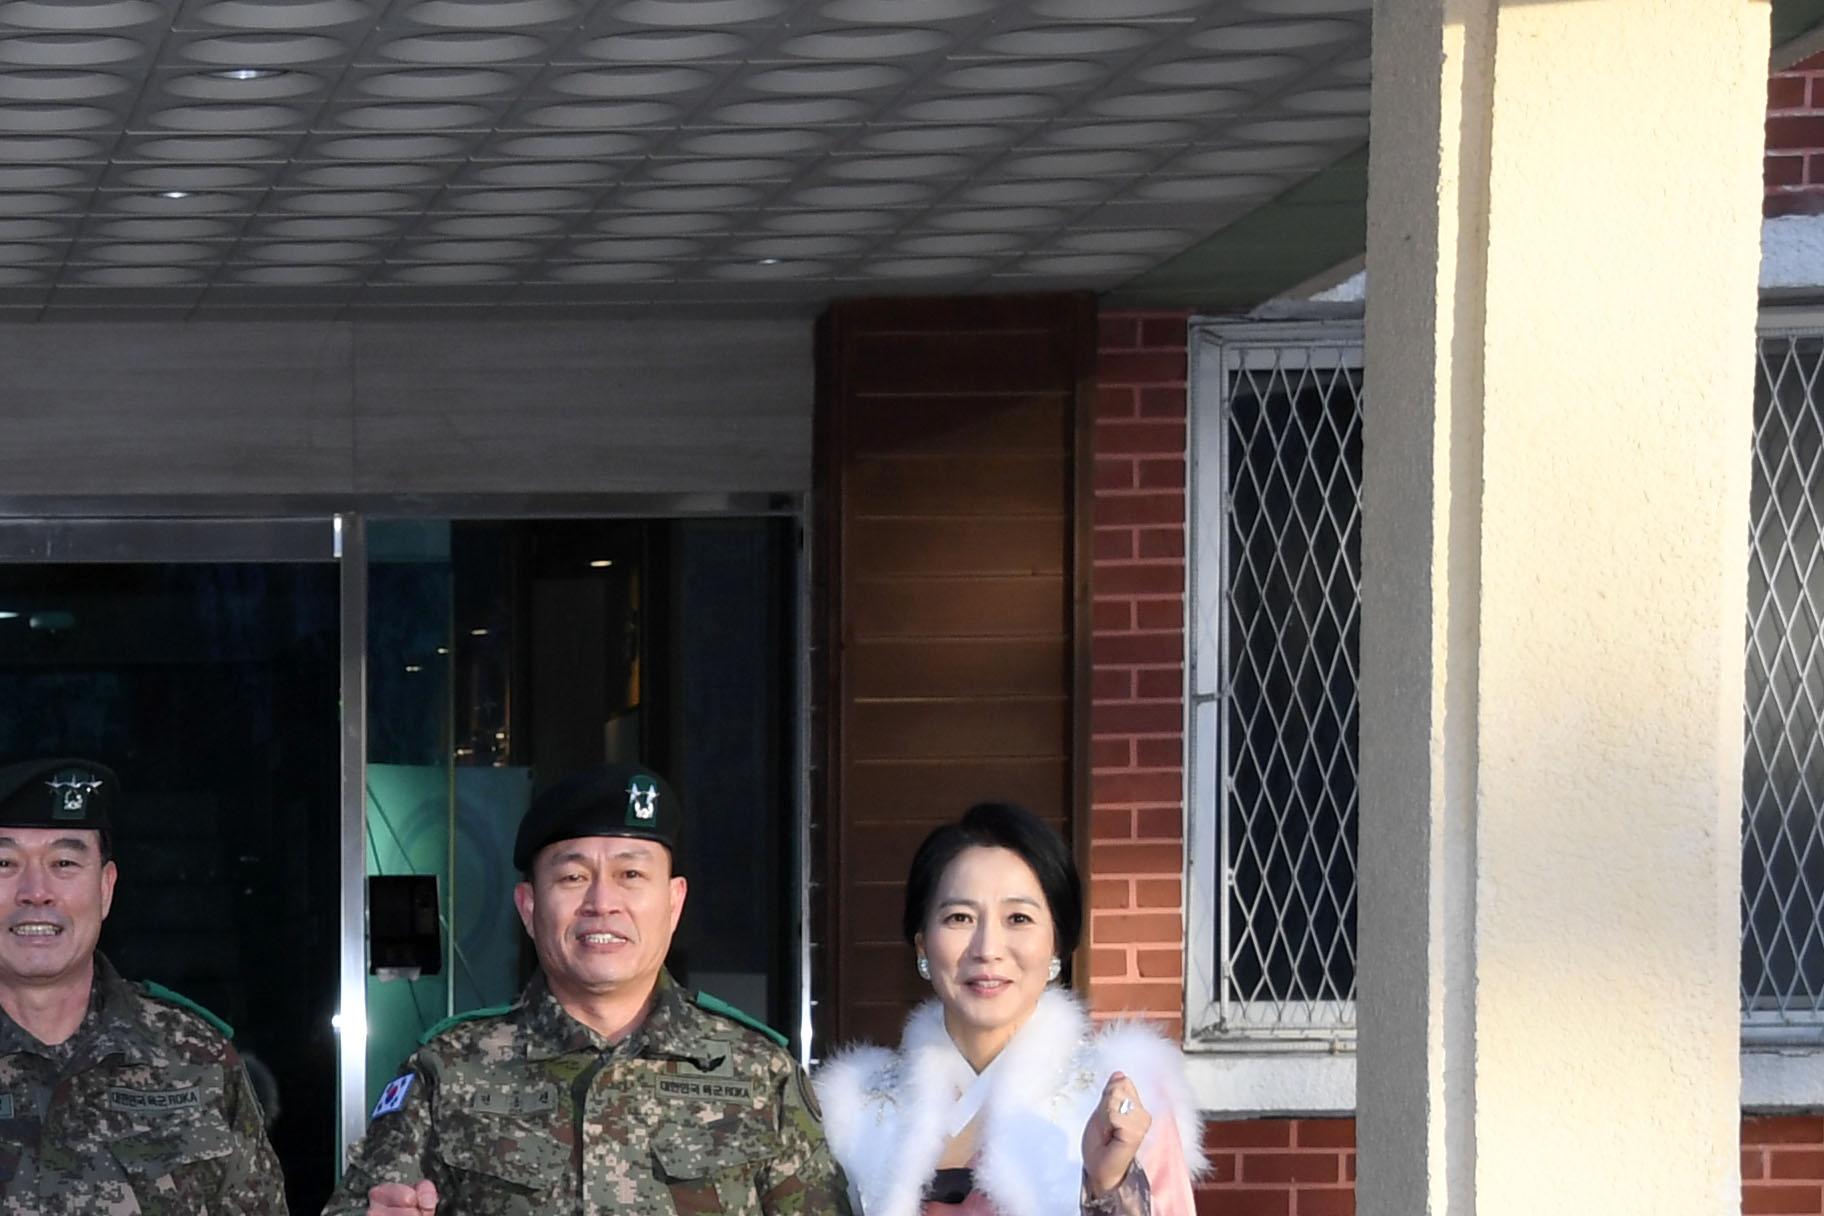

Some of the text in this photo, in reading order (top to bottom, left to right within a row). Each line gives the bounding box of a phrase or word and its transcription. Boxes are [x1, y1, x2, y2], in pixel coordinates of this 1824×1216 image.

[660, 1081, 750, 1098] 대한민국 육군 ROKA
[168, 1092, 197, 1104] ROKA
